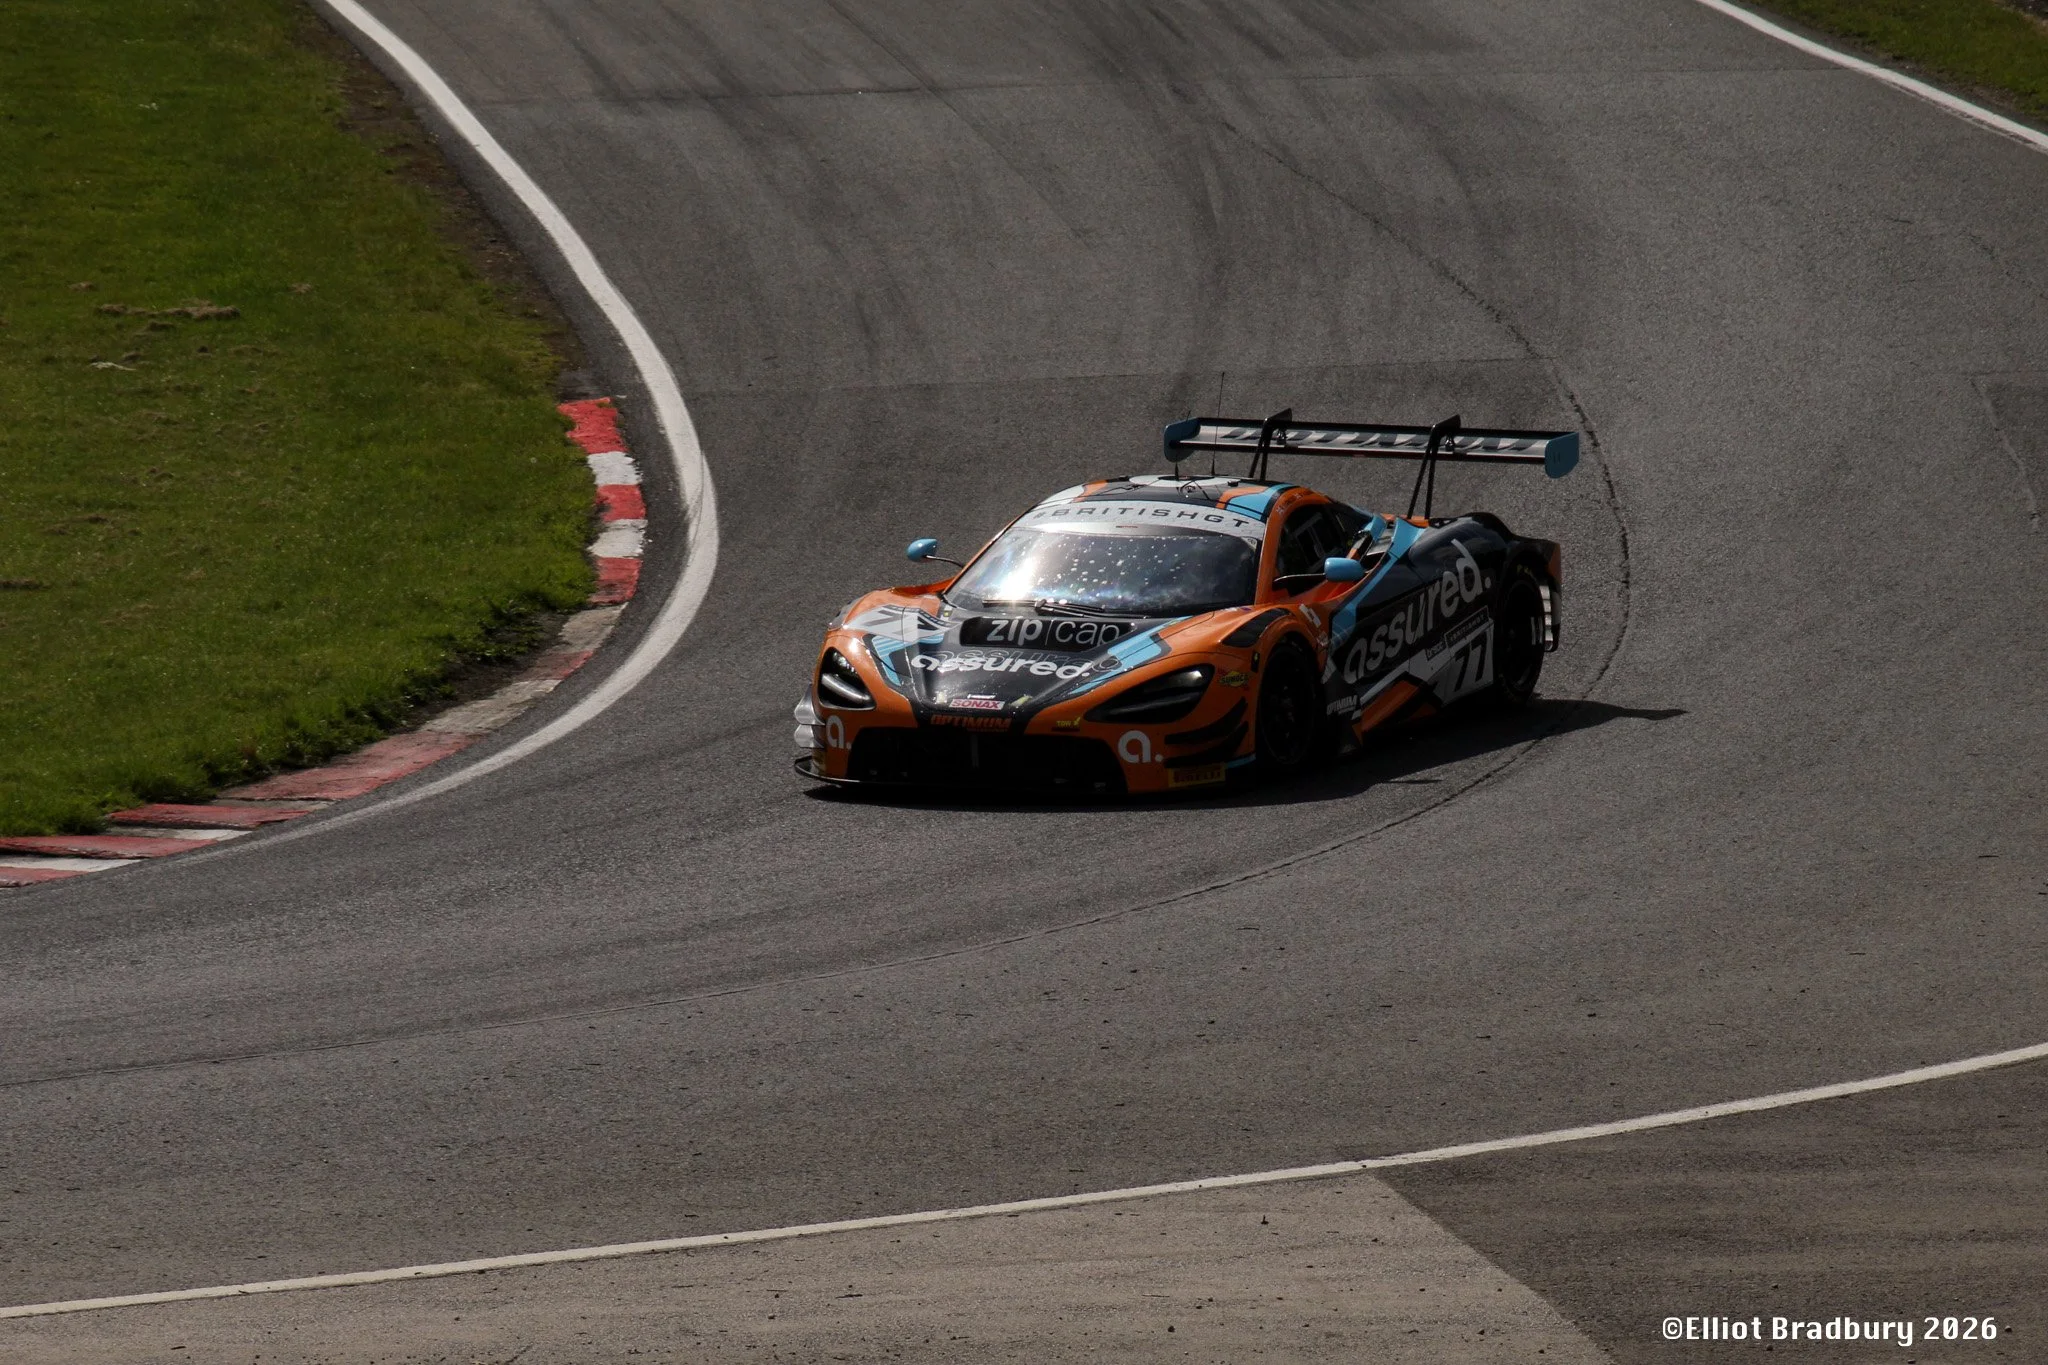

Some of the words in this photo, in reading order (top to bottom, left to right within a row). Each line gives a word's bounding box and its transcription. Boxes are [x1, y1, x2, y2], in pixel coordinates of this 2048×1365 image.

[1343, 539, 1491, 684] assured.
[986, 617, 1043, 646] zip
[911, 654, 1090, 679] assured.
[1453, 631, 1488, 692] 77
[951, 700, 1000, 709] SONAX
[930, 714, 1013, 730] OPTIMUM
